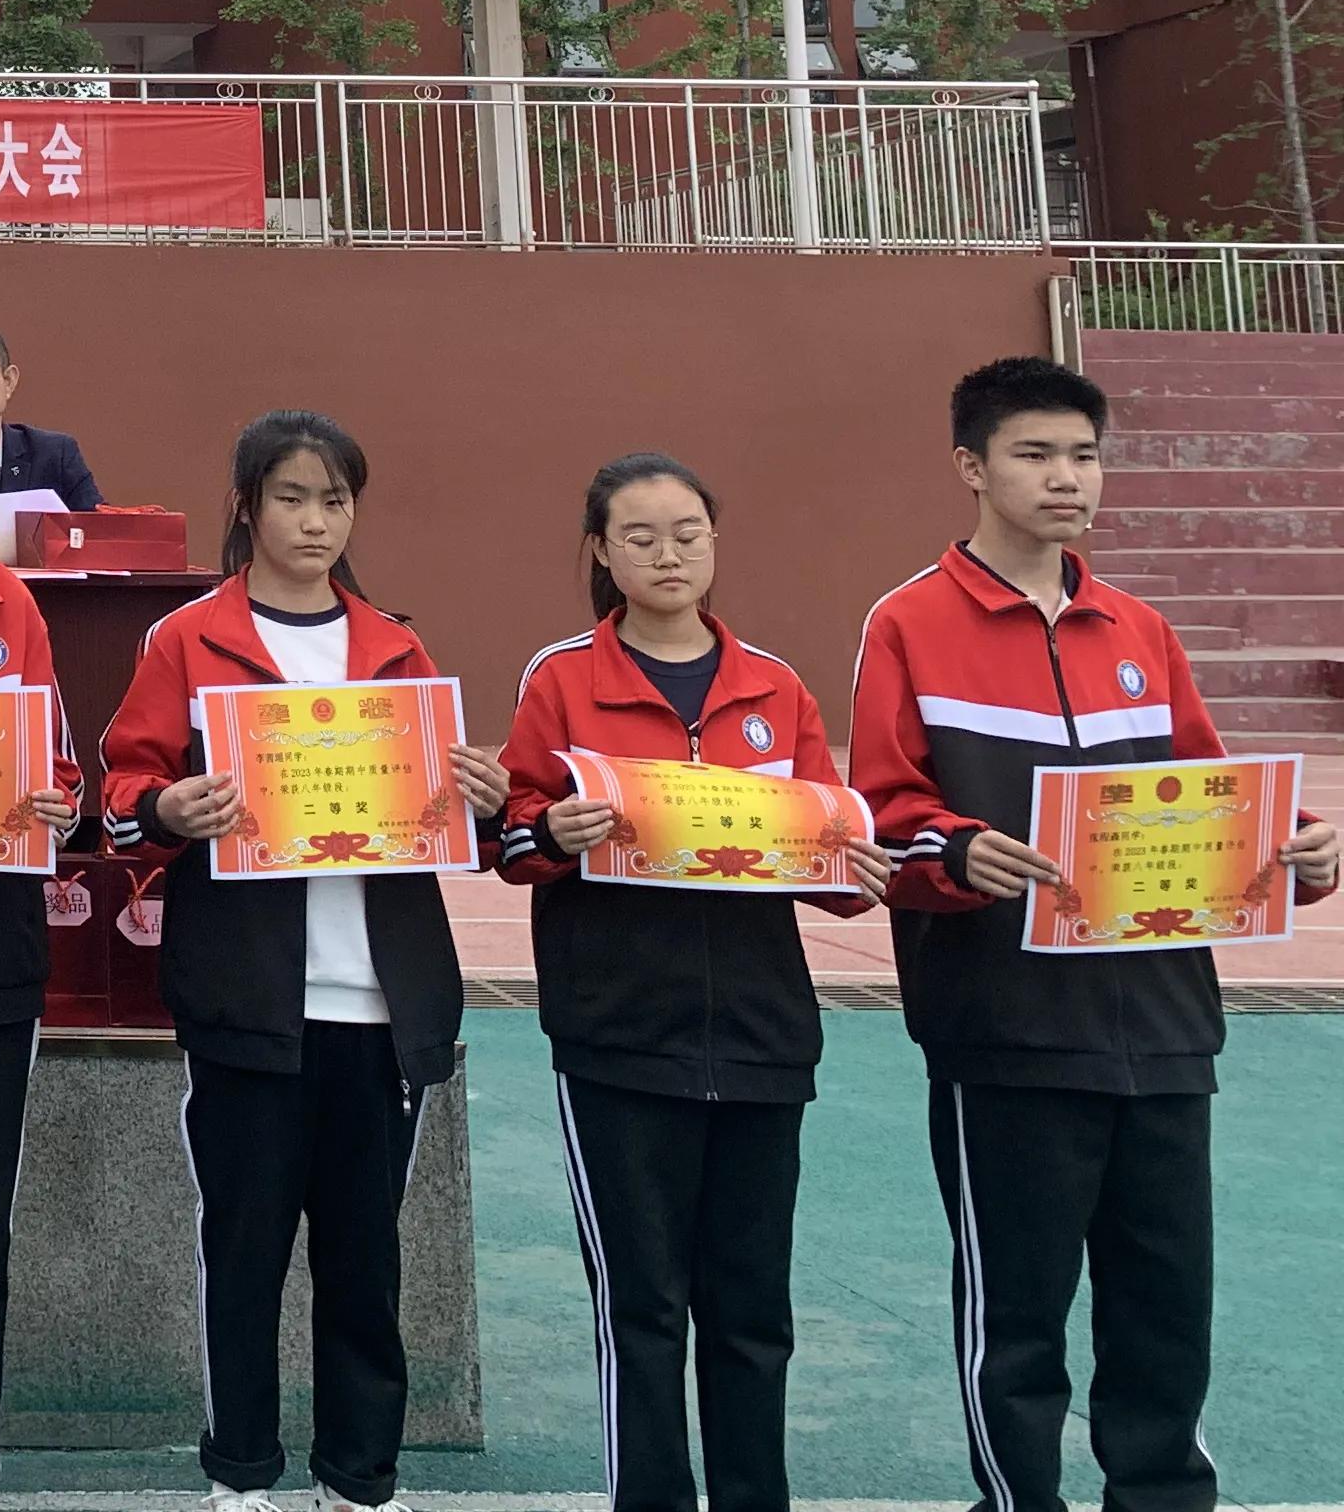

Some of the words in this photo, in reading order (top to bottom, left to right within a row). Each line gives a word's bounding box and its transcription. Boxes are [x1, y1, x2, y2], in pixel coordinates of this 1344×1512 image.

[304, 801, 369, 815] 二等奖
[692, 816, 763, 830] 二等奖
[1133, 878, 1198, 892] 二等奖
